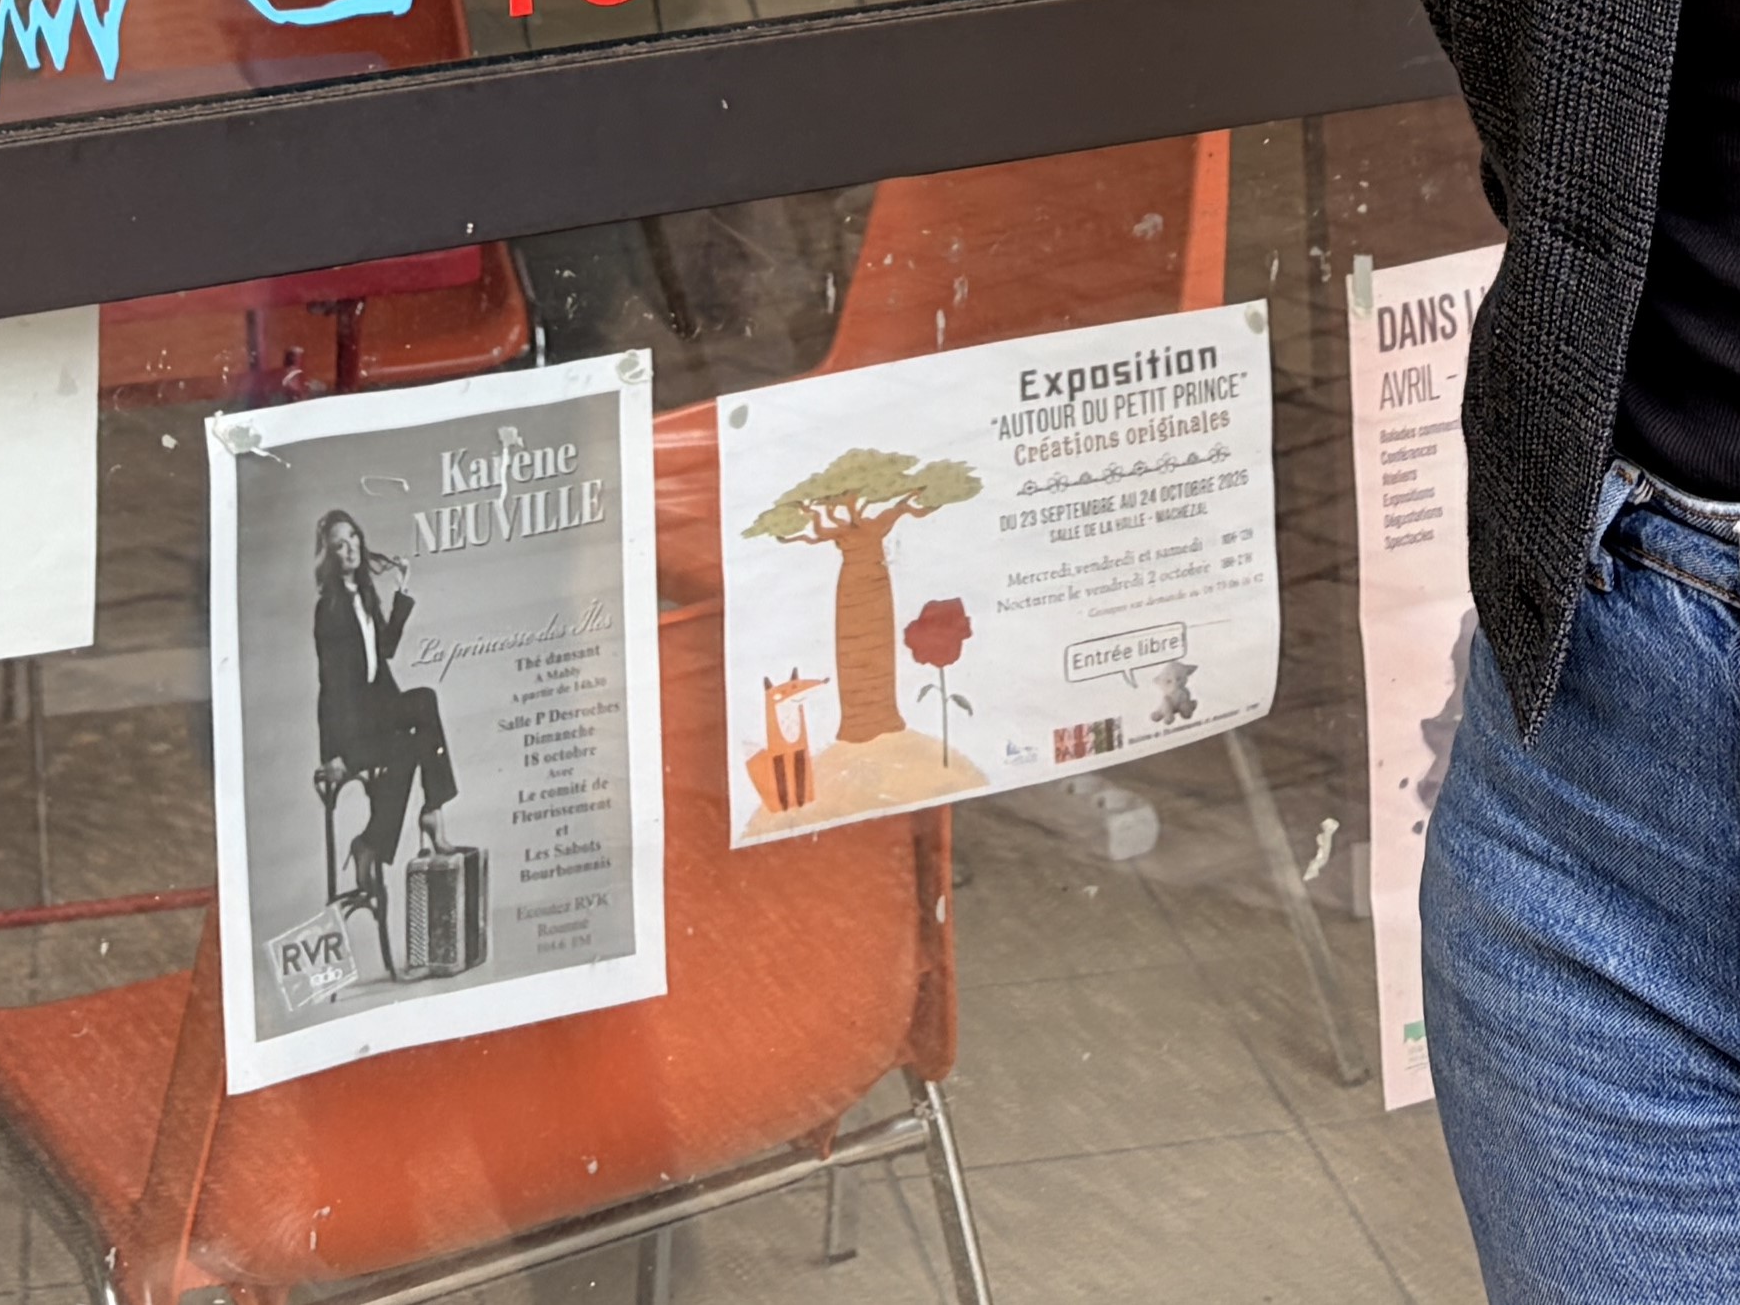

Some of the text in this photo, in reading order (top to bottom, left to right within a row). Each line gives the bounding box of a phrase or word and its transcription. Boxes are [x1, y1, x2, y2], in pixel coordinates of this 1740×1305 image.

[1376, 293, 1458, 354] DANS
[1020, 346, 1217, 401] Exposition
[1379, 364, 1441, 411] AVRIL
[1081, 397, 1108, 426] DU
[1114, 386, 1167, 420] PETIT
[1013, 409, 1231, 467] Créations originales
[999, 514, 1017, 532] DU
[1019, 509, 1038, 529] 23
[1040, 495, 1116, 525] SEPTEMBRE
[1119, 492, 1137, 510] AU
[1140, 488, 1157, 507] 24
[1160, 476, 1215, 503] OCTOBRE
[1383, 487, 1435, 508] Expositions
[412, 475, 607, 557] NEUVILLE
[1384, 529, 1434, 550] Spectacles
[1084, 571, 1144, 597] vendredi
[1159, 561, 1211, 583] octobre
[515, 645, 600, 672] Thé dansant
[1072, 644, 1133, 671] Entrée
[498, 715, 532, 731] Salle
[548, 702, 620, 724] Desroches
[523, 725, 595, 748] Dimanche
[524, 745, 596, 767] 18 octobre
[518, 776, 610, 805] Le comité de
[511, 798, 611, 825] Fleurissement
[524, 839, 602, 863] Les Sabots
[519, 855, 612, 883] Bourbonnais
[281, 930, 345, 976] RVR
